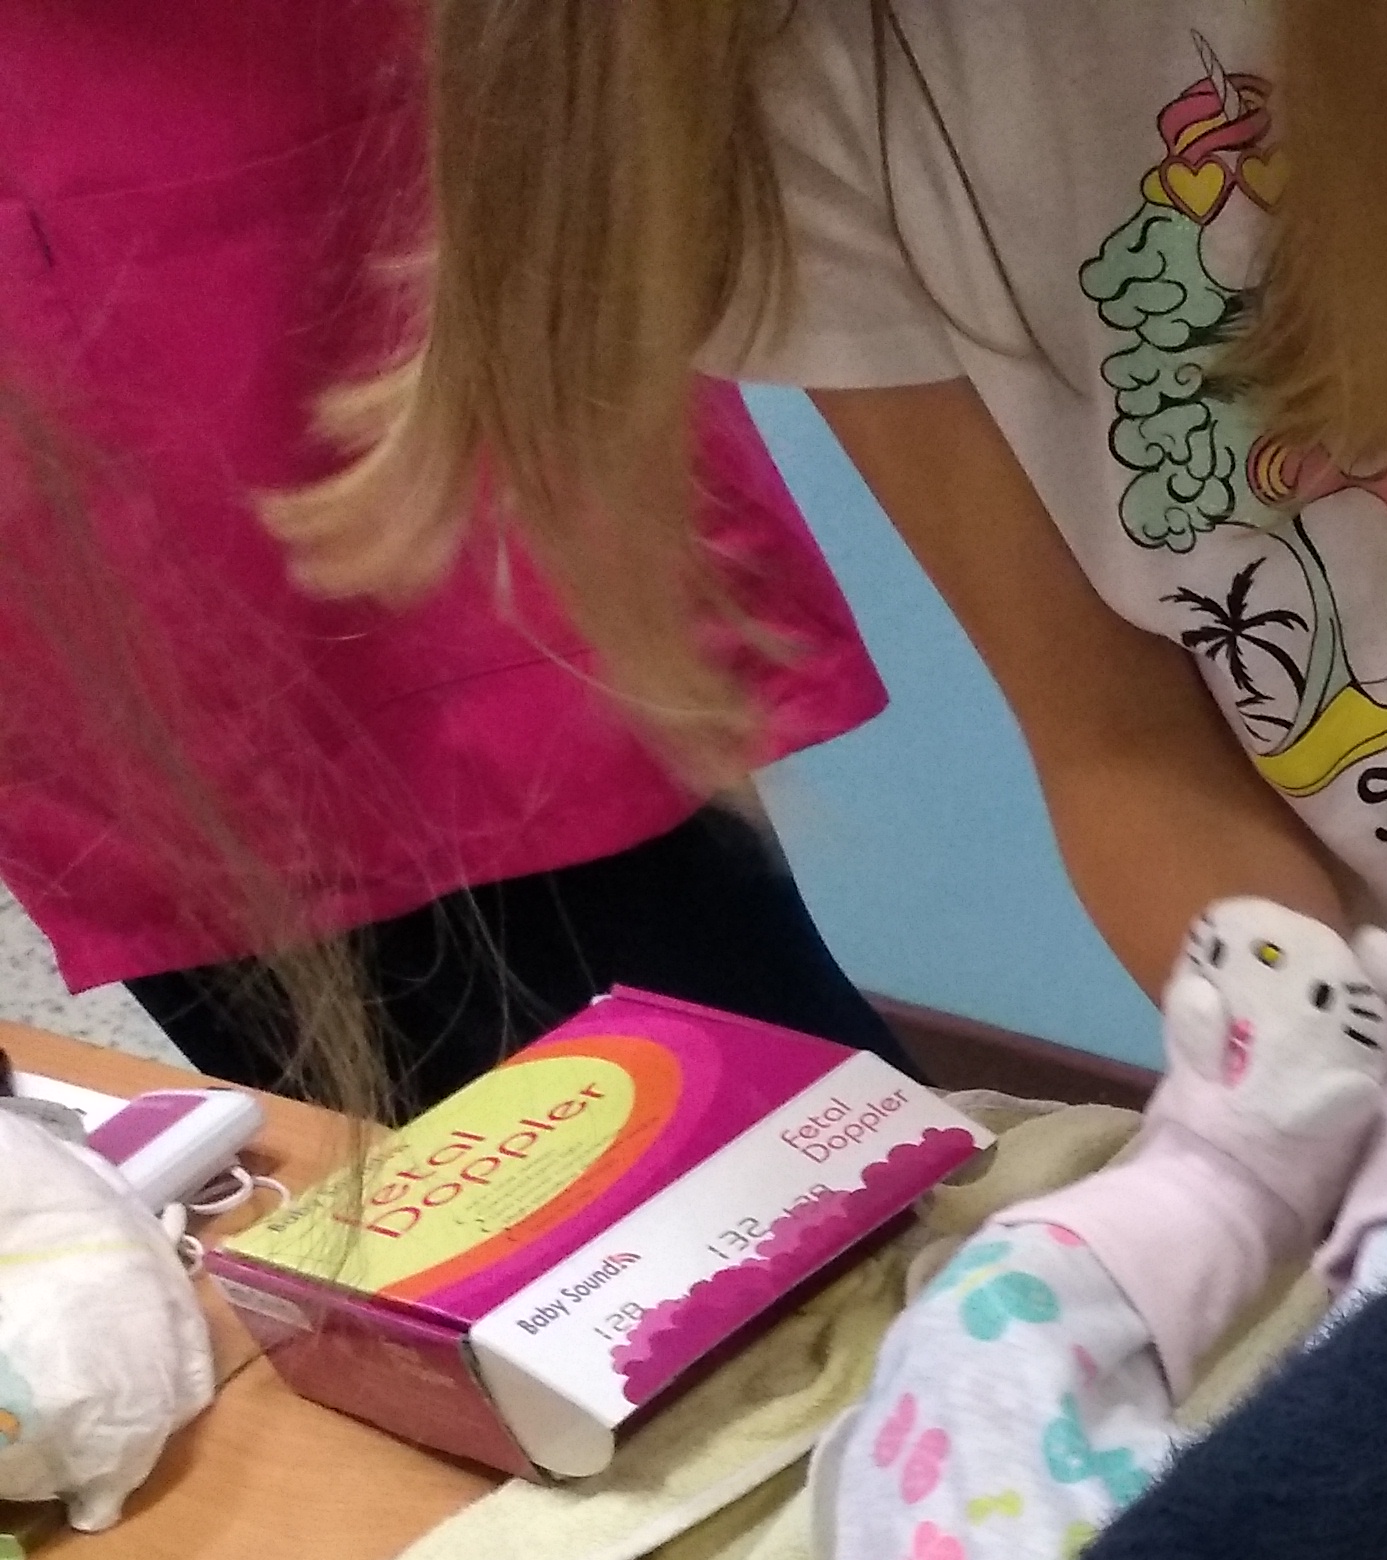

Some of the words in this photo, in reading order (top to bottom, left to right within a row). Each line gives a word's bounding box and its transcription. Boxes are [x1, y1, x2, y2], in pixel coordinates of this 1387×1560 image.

[781, 1096, 852, 1150] Fetal
[801, 1088, 909, 1164] Doppler
[366, 1082, 605, 1238] Doppler
[707, 1217, 770, 1260] 132
[516, 1297, 572, 1336] Baby
[594, 1301, 645, 1341] 128
